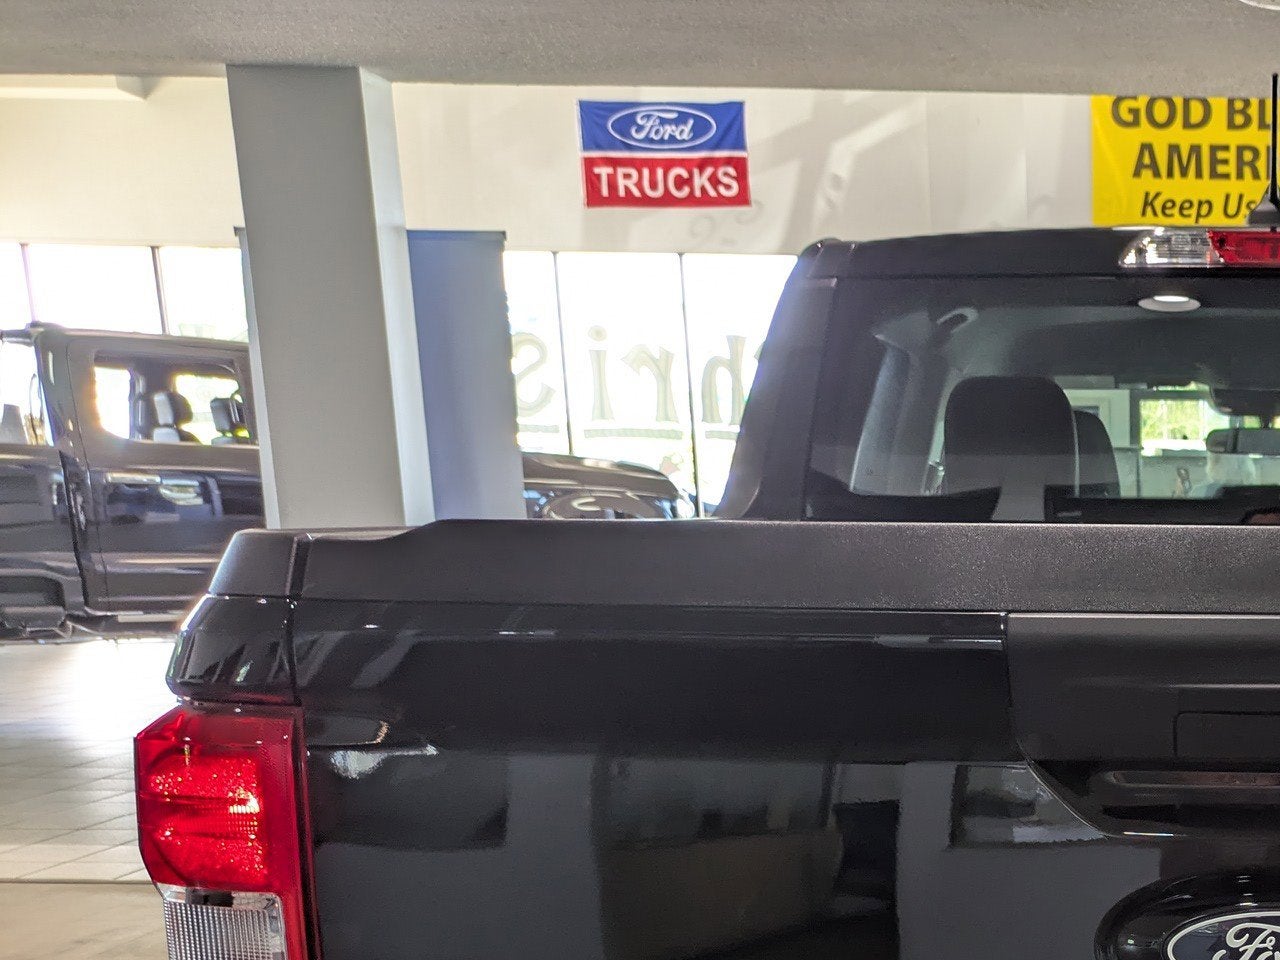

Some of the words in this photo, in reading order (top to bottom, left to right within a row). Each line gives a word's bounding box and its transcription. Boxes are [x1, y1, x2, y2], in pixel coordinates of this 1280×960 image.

[630, 110, 694, 141] Ford
[1111, 95, 1213, 131] GOD
[593, 165, 740, 199] TRUCKS
[1141, 191, 1213, 223] Keep
